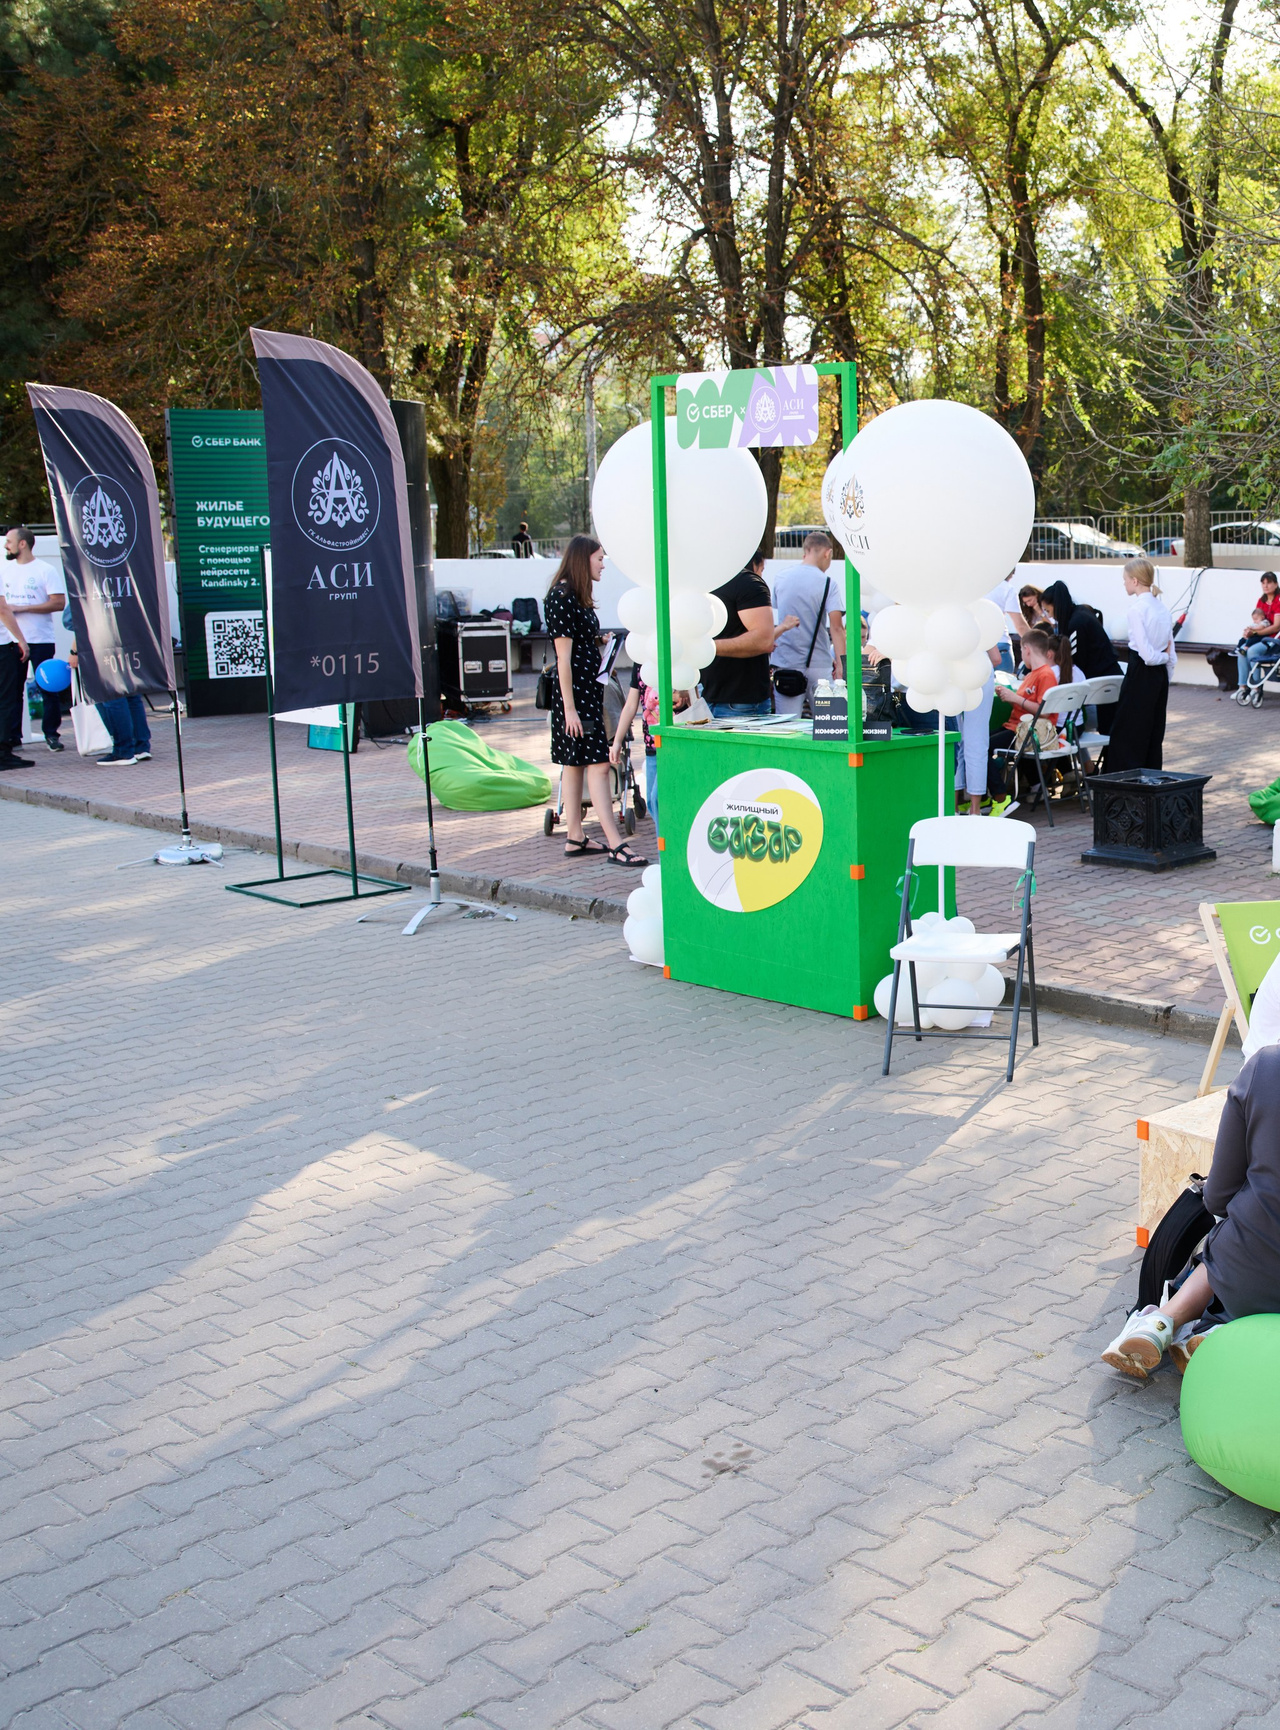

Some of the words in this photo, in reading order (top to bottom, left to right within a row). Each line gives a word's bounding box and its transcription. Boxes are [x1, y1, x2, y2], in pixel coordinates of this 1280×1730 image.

[782, 398, 804, 411] АСИ
[702, 404, 733, 419] СБЕР
[205, 437, 231, 447] СБЕР
[232, 438, 262, 447] БАНК
[196, 501, 244, 512] ЖИЛЬЕ
[197, 515, 270, 528] БУДУЩЕГО
[198, 544, 259, 555] Сгенерирова
[206, 557, 252, 566] помощью
[200, 566, 250, 578] нейросети
[307, 561, 375, 591] АСИ
[92, 576, 133, 601] АСИ
[201, 577, 249, 589] Kandinsky
[329, 592, 358, 601] ГРУПП
[815, 713, 831, 721] МОЙ
[726, 803, 779, 816] ЖИЛИЩНЫЙ
